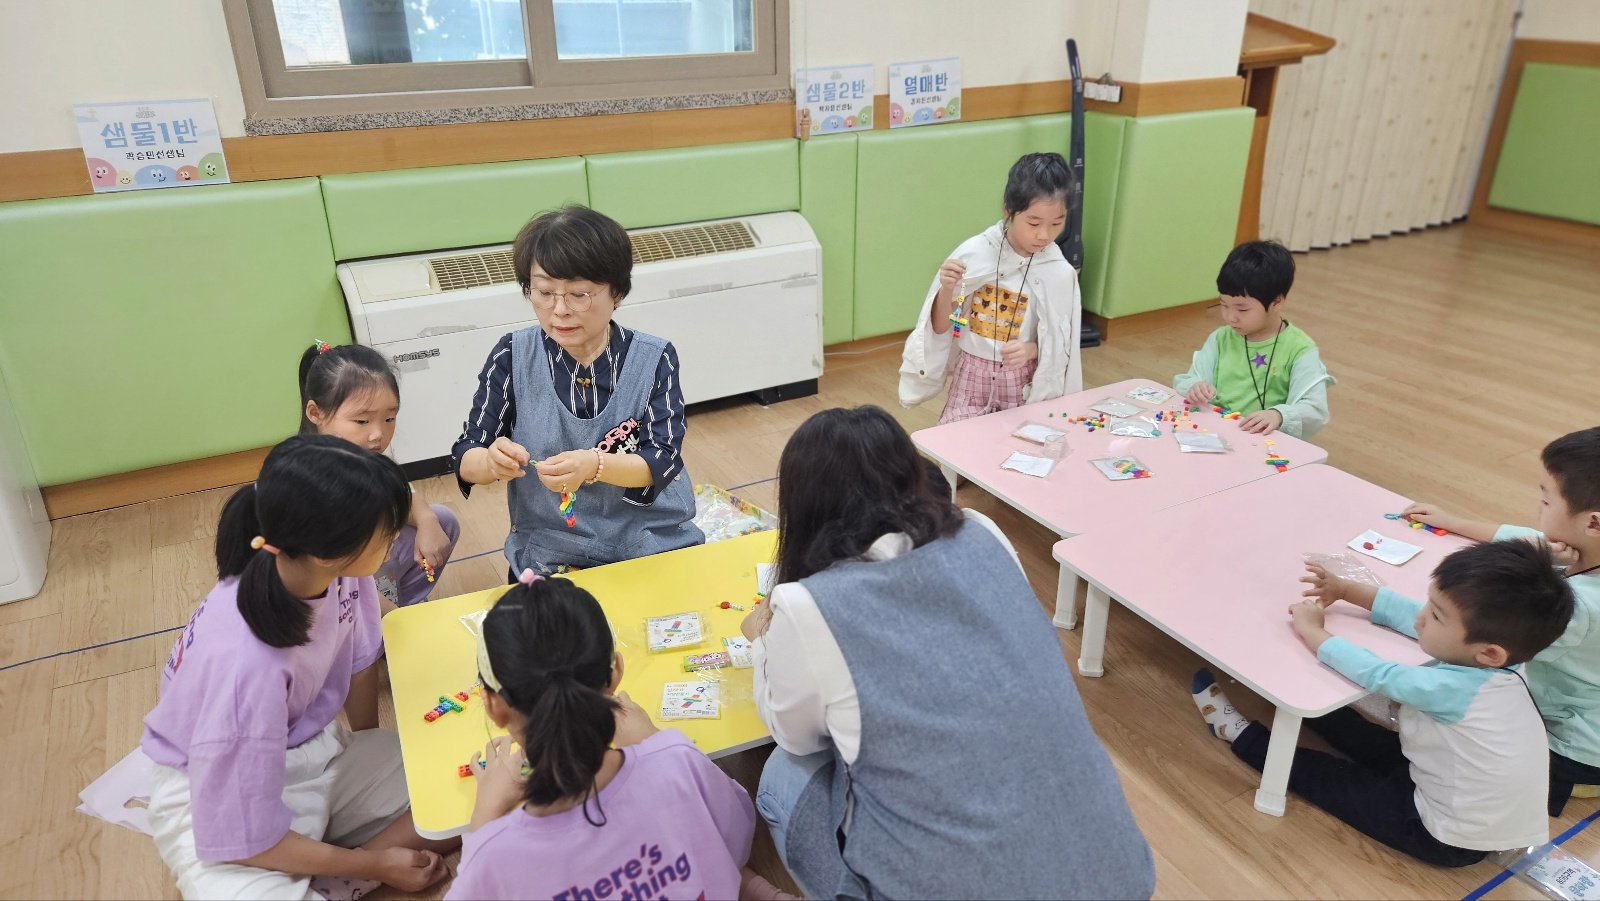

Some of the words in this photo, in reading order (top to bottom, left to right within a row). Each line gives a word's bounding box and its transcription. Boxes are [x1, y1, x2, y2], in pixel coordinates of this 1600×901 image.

[806, 79, 866, 103] 샘물2반
[904, 72, 949, 96] 열매반
[100, 118, 198, 149] 샘물1반
[125, 149, 185, 161] 곽승민선생님
[621, 852, 691, 901] thing
